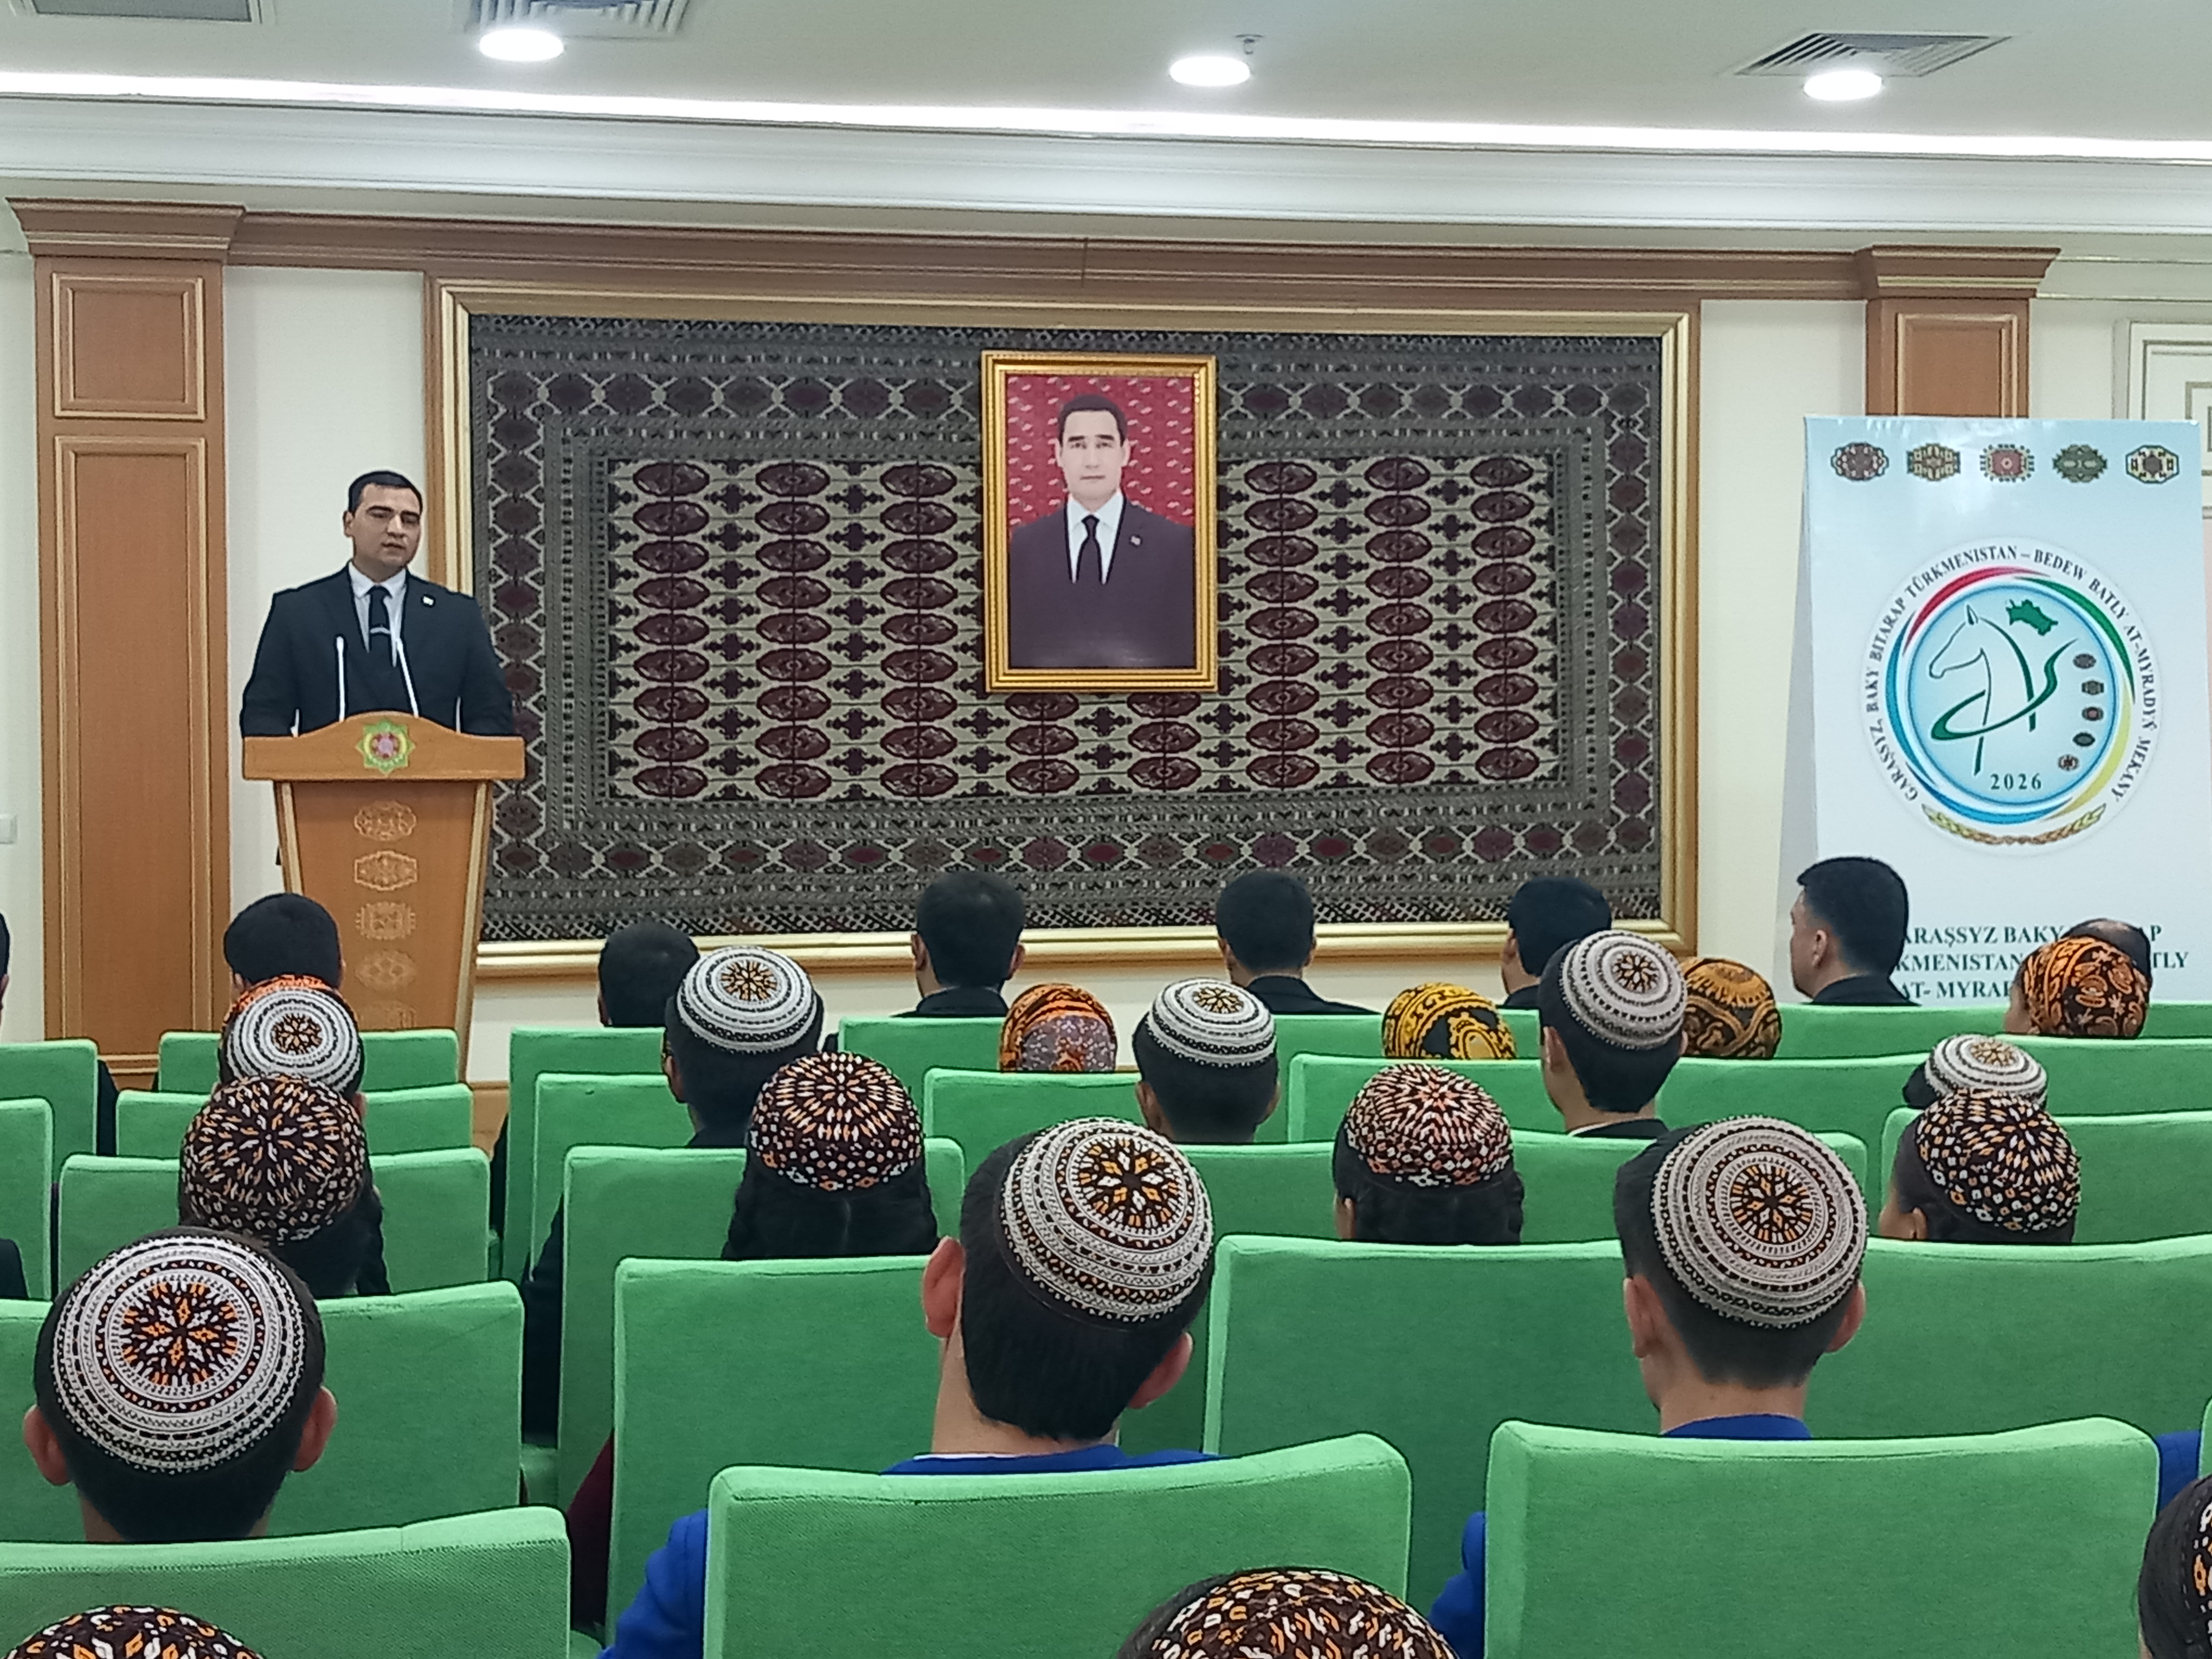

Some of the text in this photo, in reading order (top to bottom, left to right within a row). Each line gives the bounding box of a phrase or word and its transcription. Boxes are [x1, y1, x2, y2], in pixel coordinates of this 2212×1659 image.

[1904, 545, 2017, 597] TÜRKMENISTAN
[2034, 549, 2087, 580] BEDEW
[2088, 578, 2129, 619] BATLY
[1869, 597, 1906, 661] BITARAP
[1865, 667, 1879, 712] BAKY
[1990, 773, 2042, 790] 2026
[2111, 736, 2151, 802] MEKANY
[2004, 926, 2064, 943] BAKY
[1896, 951, 2189, 972] KMENISTAN TLY
